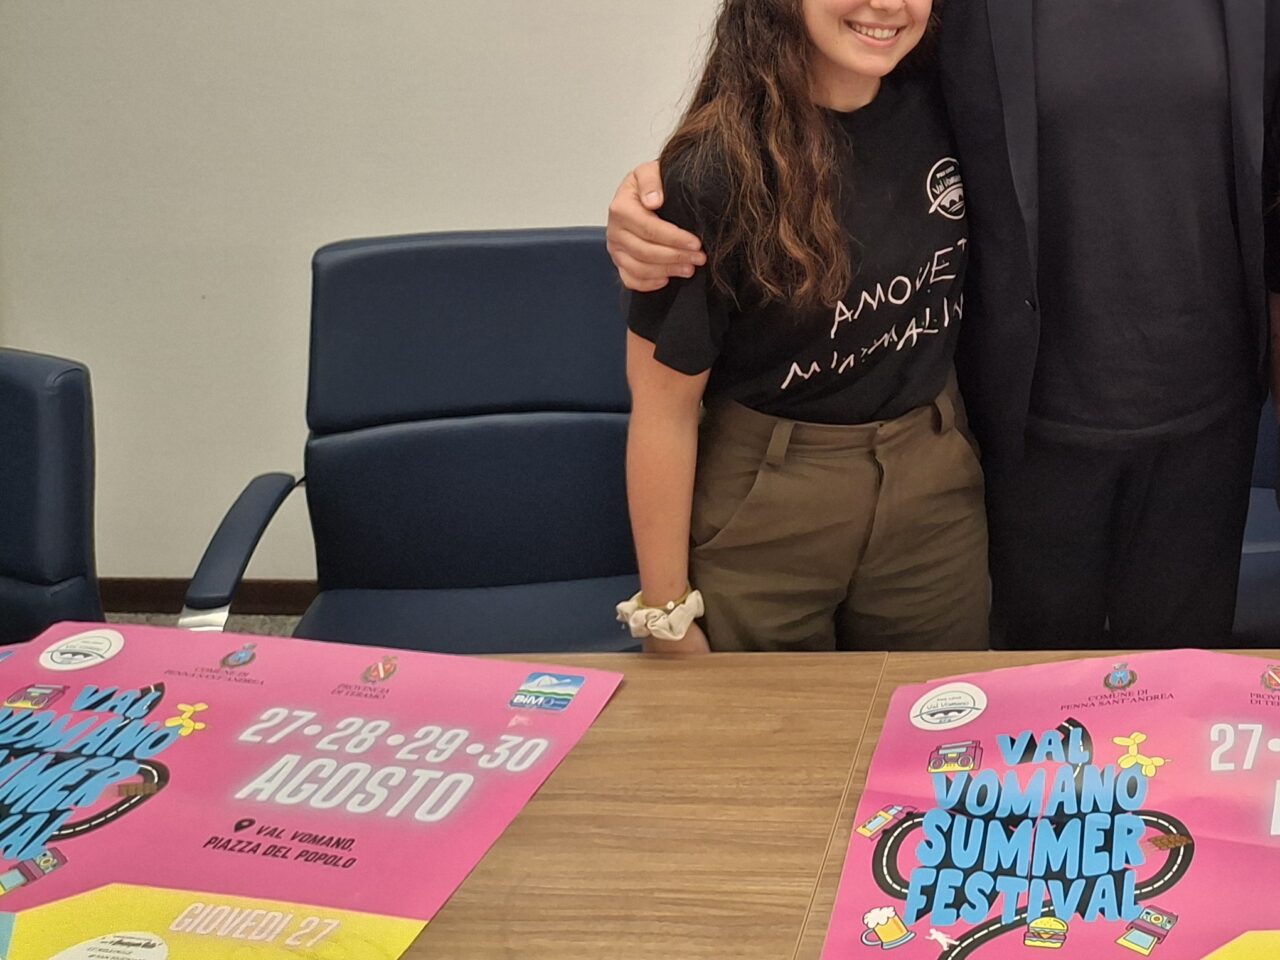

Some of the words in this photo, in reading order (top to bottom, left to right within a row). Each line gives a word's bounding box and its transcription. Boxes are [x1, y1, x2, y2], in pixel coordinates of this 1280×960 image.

[997, 728, 1090, 766] VAL
[234, 754, 475, 823] AGOSTO
[932, 765, 1149, 818] VOMANO
[203, 837, 260, 856] PIAZZA
[261, 843, 290, 860] DEL
[294, 849, 357, 869] POPOLO
[256, 825, 287, 840] VAL
[916, 809, 1146, 879] SUMMER
[904, 868, 1142, 926] FESTIVAL
[286, 917, 342, 948] 27
